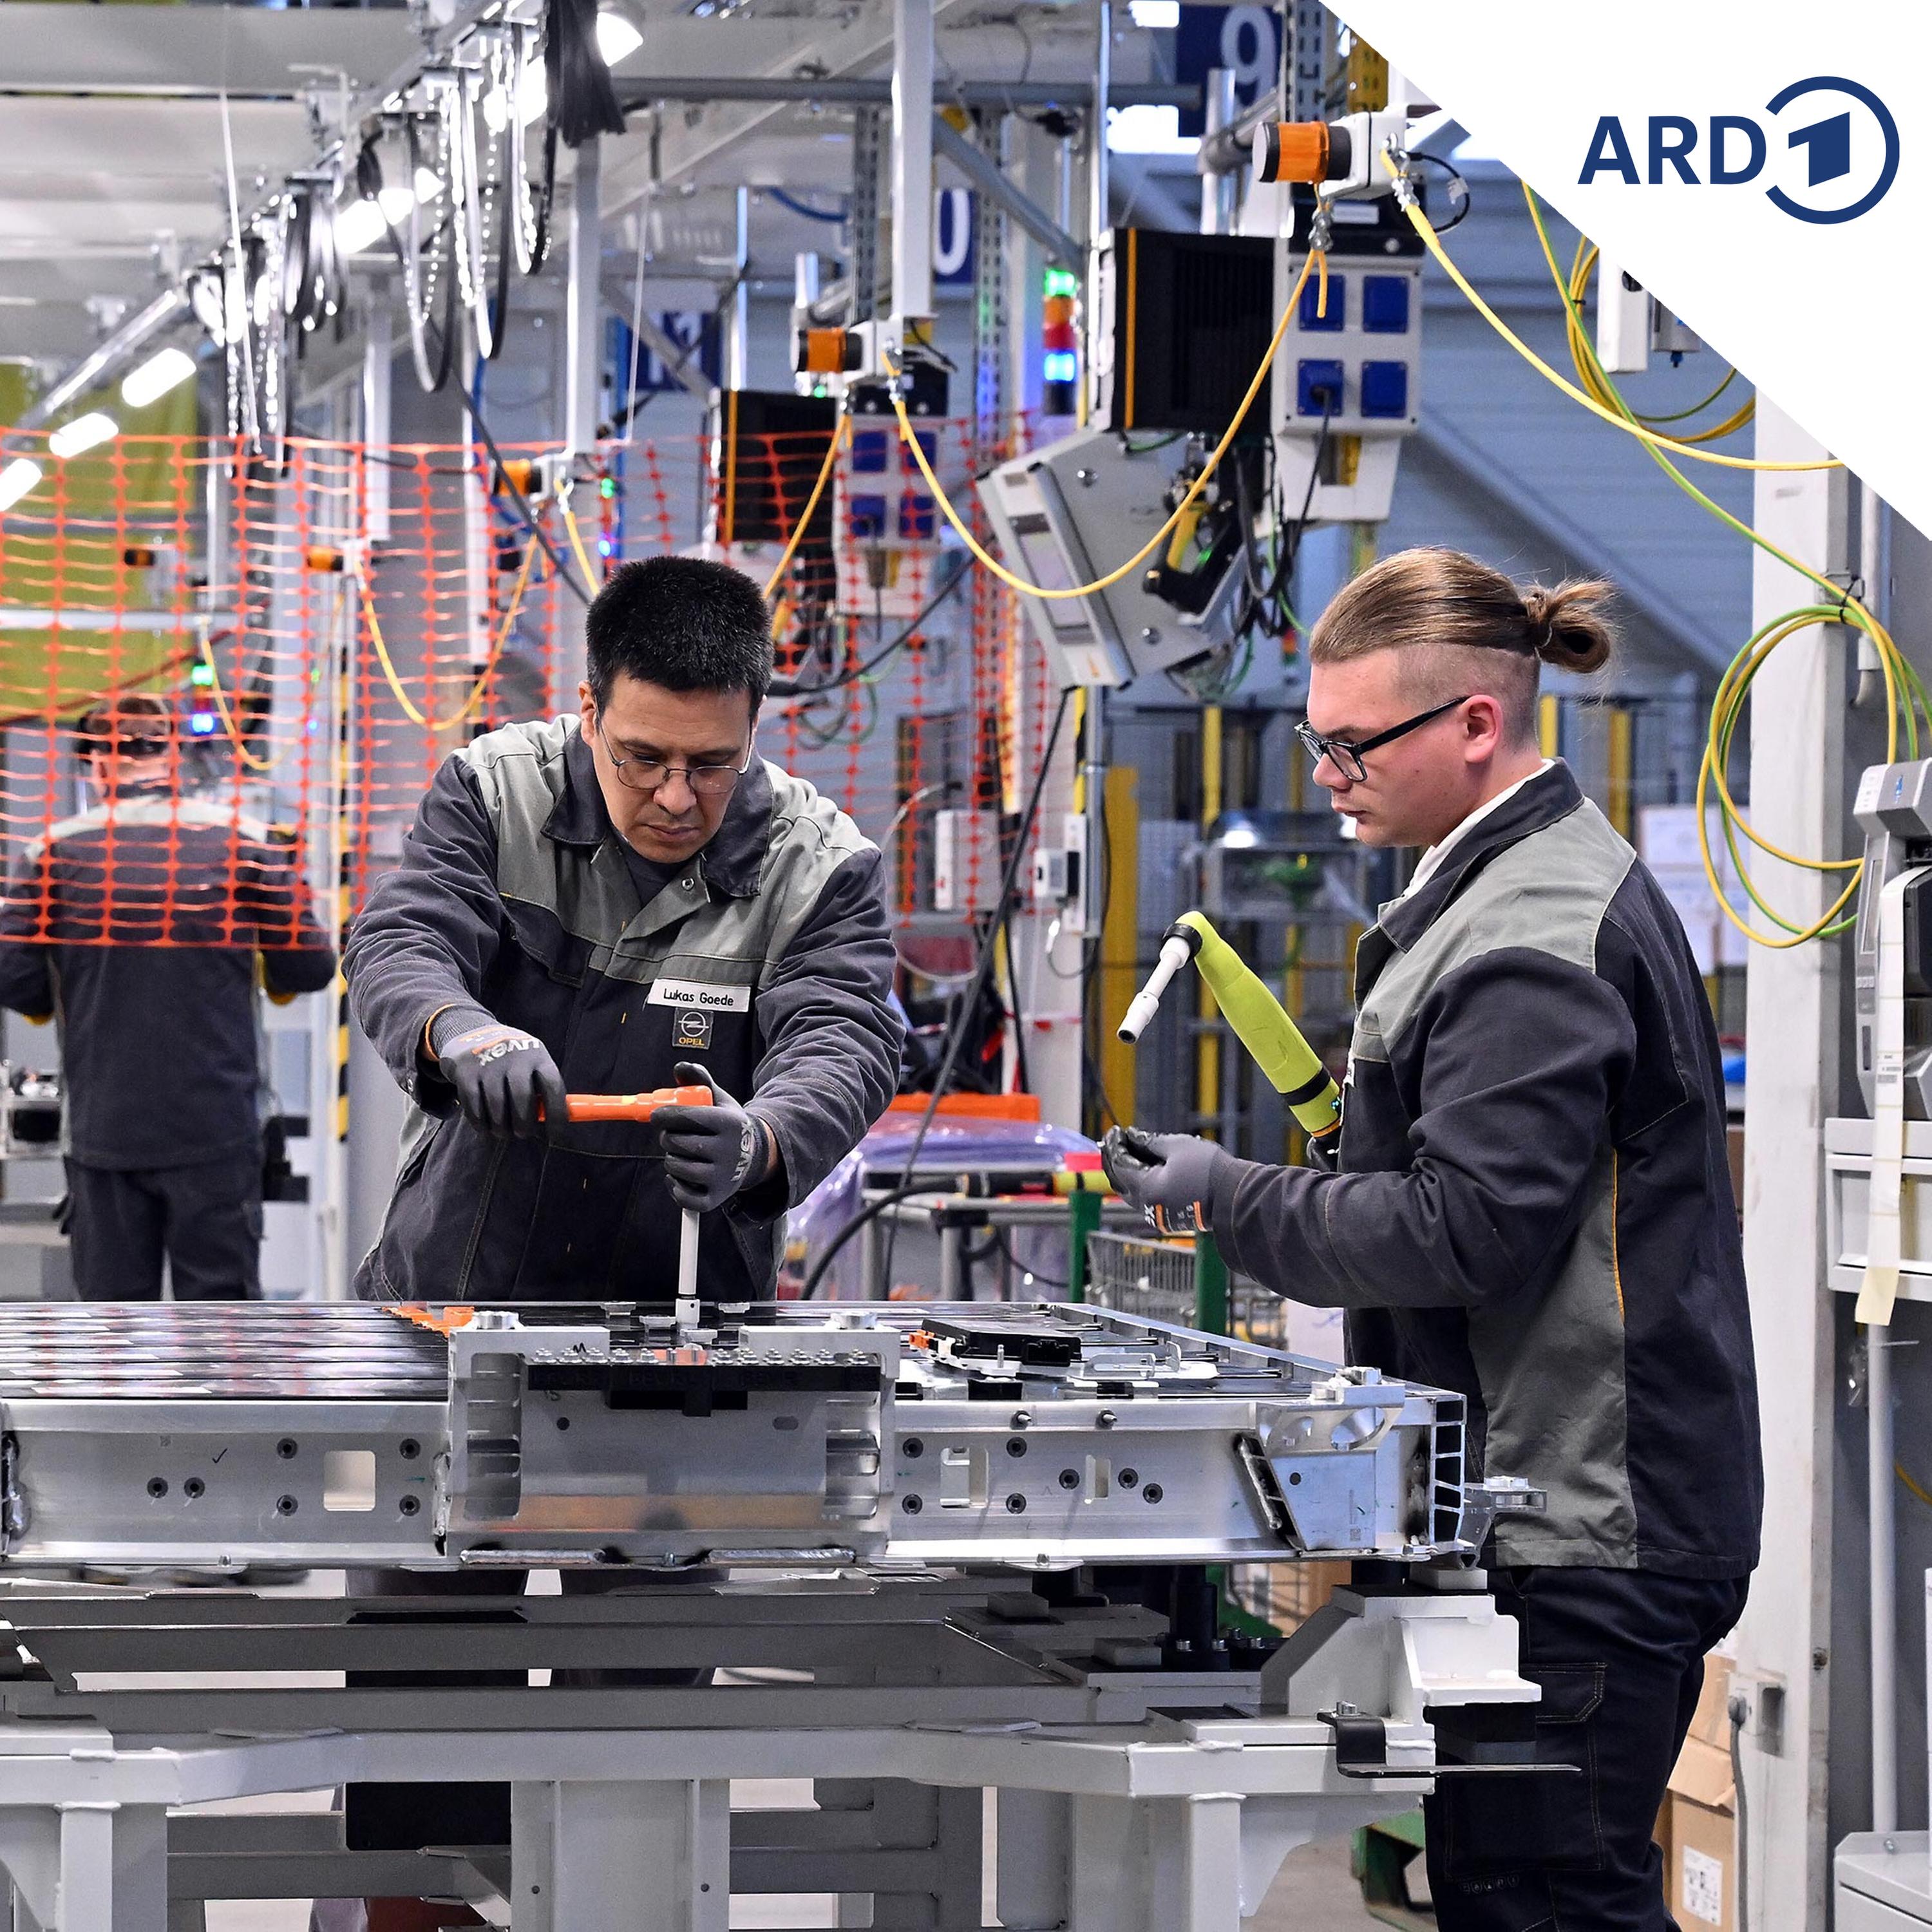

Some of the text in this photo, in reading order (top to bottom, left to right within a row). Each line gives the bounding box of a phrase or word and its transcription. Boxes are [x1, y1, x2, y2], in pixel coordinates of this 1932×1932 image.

[1221, 5, 1276, 120] 9
[663, 988, 734, 1007] Lukas Goede
[478, 1039, 540, 1066] uvex
[678, 1037, 705, 1046] OPEL
